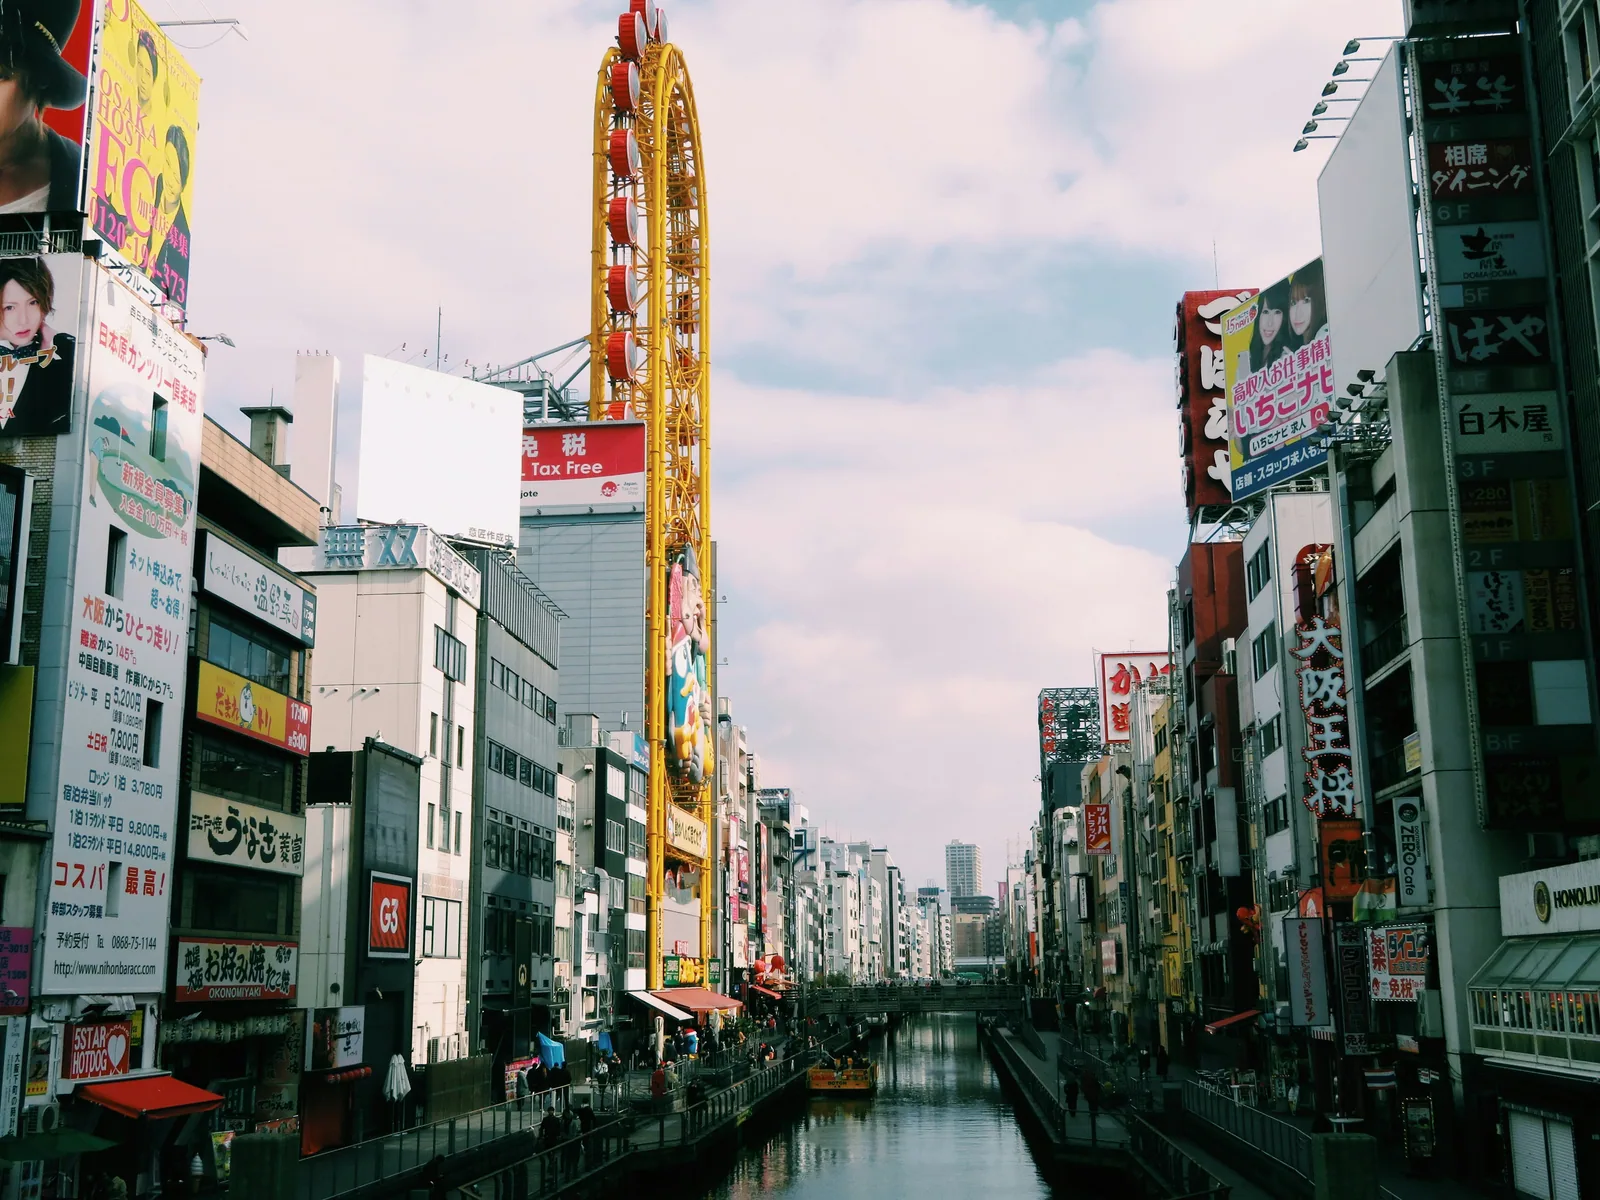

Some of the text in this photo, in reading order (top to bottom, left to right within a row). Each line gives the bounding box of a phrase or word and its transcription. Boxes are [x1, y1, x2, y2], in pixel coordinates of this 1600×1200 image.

[100, 69, 158, 149] OSAKA
[97, 94, 144, 155] HOST
[1444, 143, 1488, 167] 相席
[1432, 164, 1531, 194] ダイニング
[1464, 287, 1490, 303] 5F
[1459, 404, 1552, 435] 白木屋
[531, 460, 603, 476] Tax Free
[290, 701, 309, 725] 17:00
[1290, 616, 1355, 817] 大阪王将
[87, 731, 107, 753] 土日祝
[131, 779, 163, 799] 3,780円
[1088, 812, 1097, 842] ドラッグ
[1097, 807, 1108, 835] ツルハ
[1401, 825, 1417, 896] ZERO cafe
[54, 861, 106, 891] コスパ
[380, 897, 399, 934] G3
[56, 932, 89, 949] 予約受付
[111, 935, 157, 950] 0868-75-1144
[53, 960, 156, 978] http://www.nihonbaracc.com
[204, 942, 265, 983] お好み焼
[208, 987, 261, 999] OKONOMIYAKI
[1389, 977, 1413, 998] 免税
[72, 1049, 108, 1075] HOTDOG
